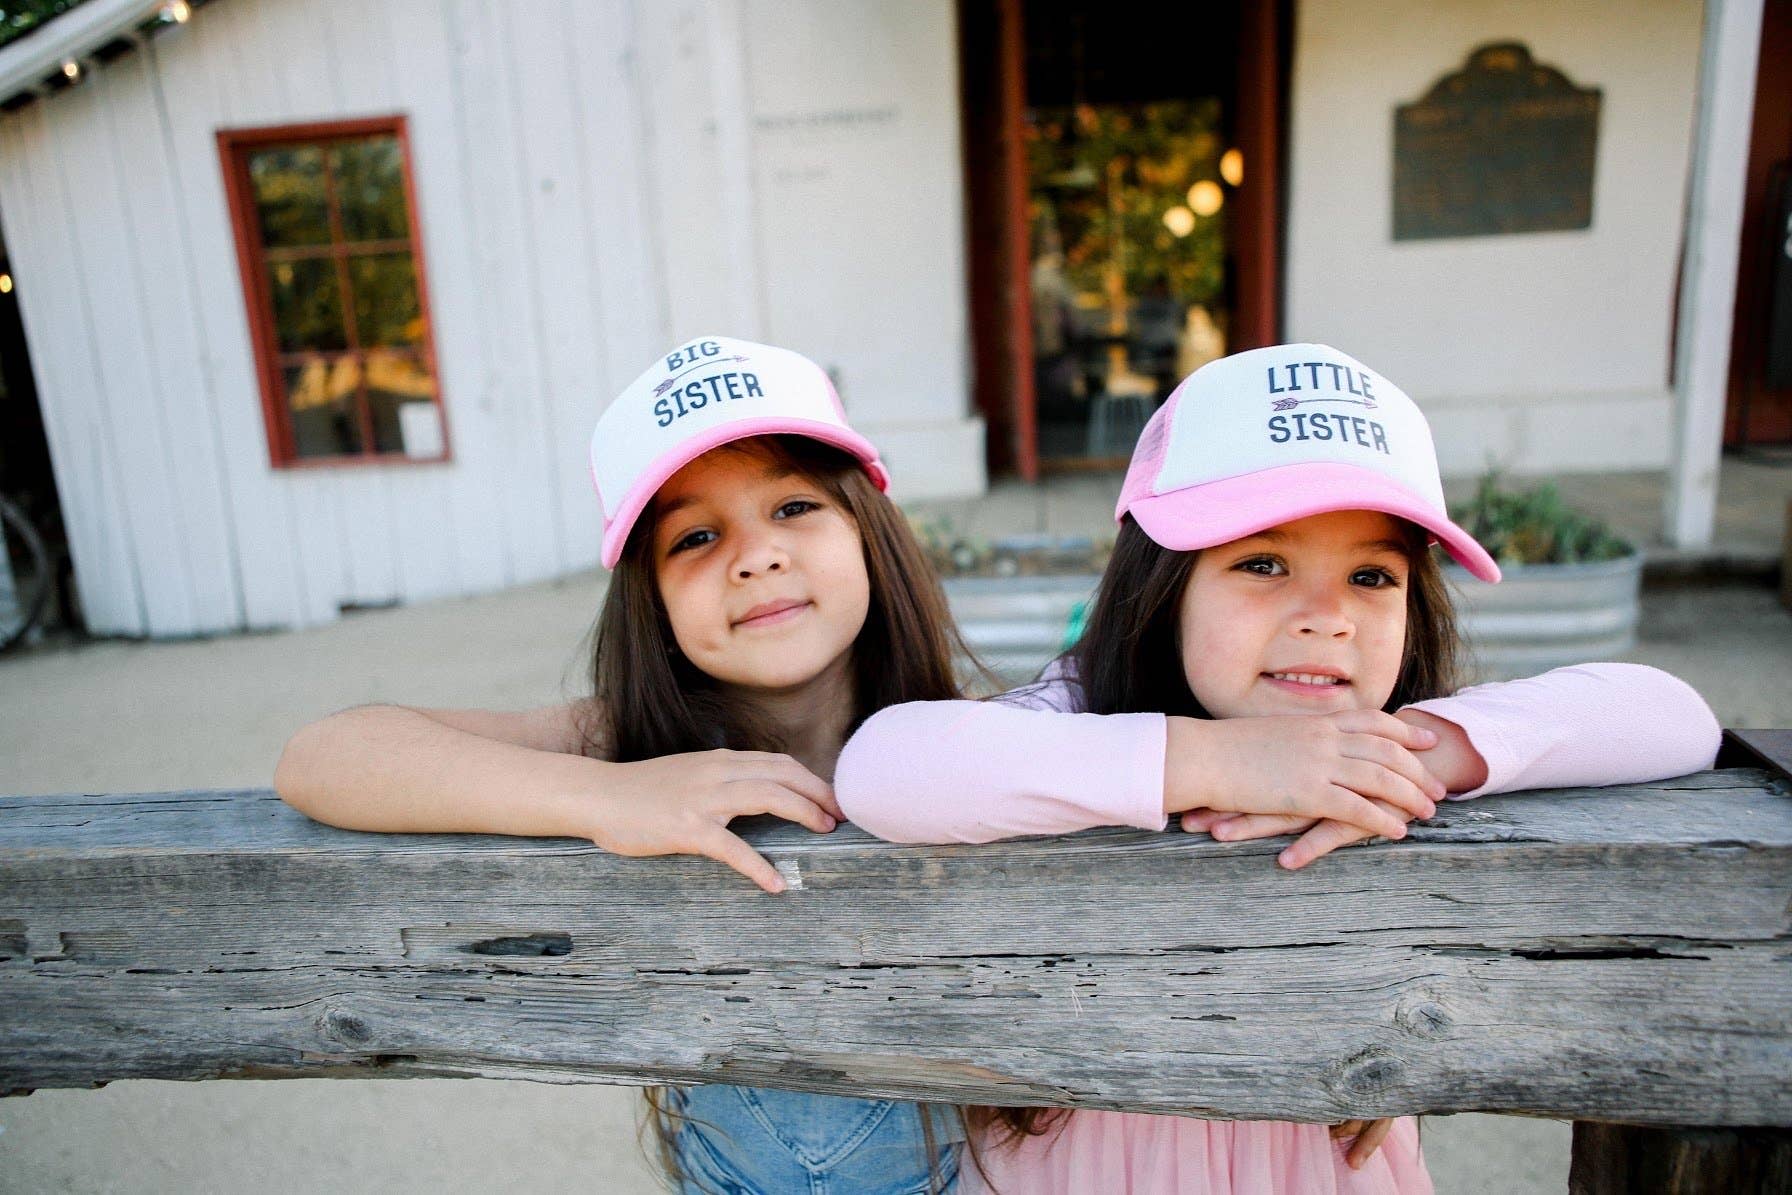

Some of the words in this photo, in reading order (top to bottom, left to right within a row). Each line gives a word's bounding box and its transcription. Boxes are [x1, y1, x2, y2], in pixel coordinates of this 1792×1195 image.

[667, 341, 722, 371] BIG
[654, 372, 764, 427] SISTER
[1267, 362, 1376, 400] LITTLE
[1268, 413, 1390, 455] SISTER
